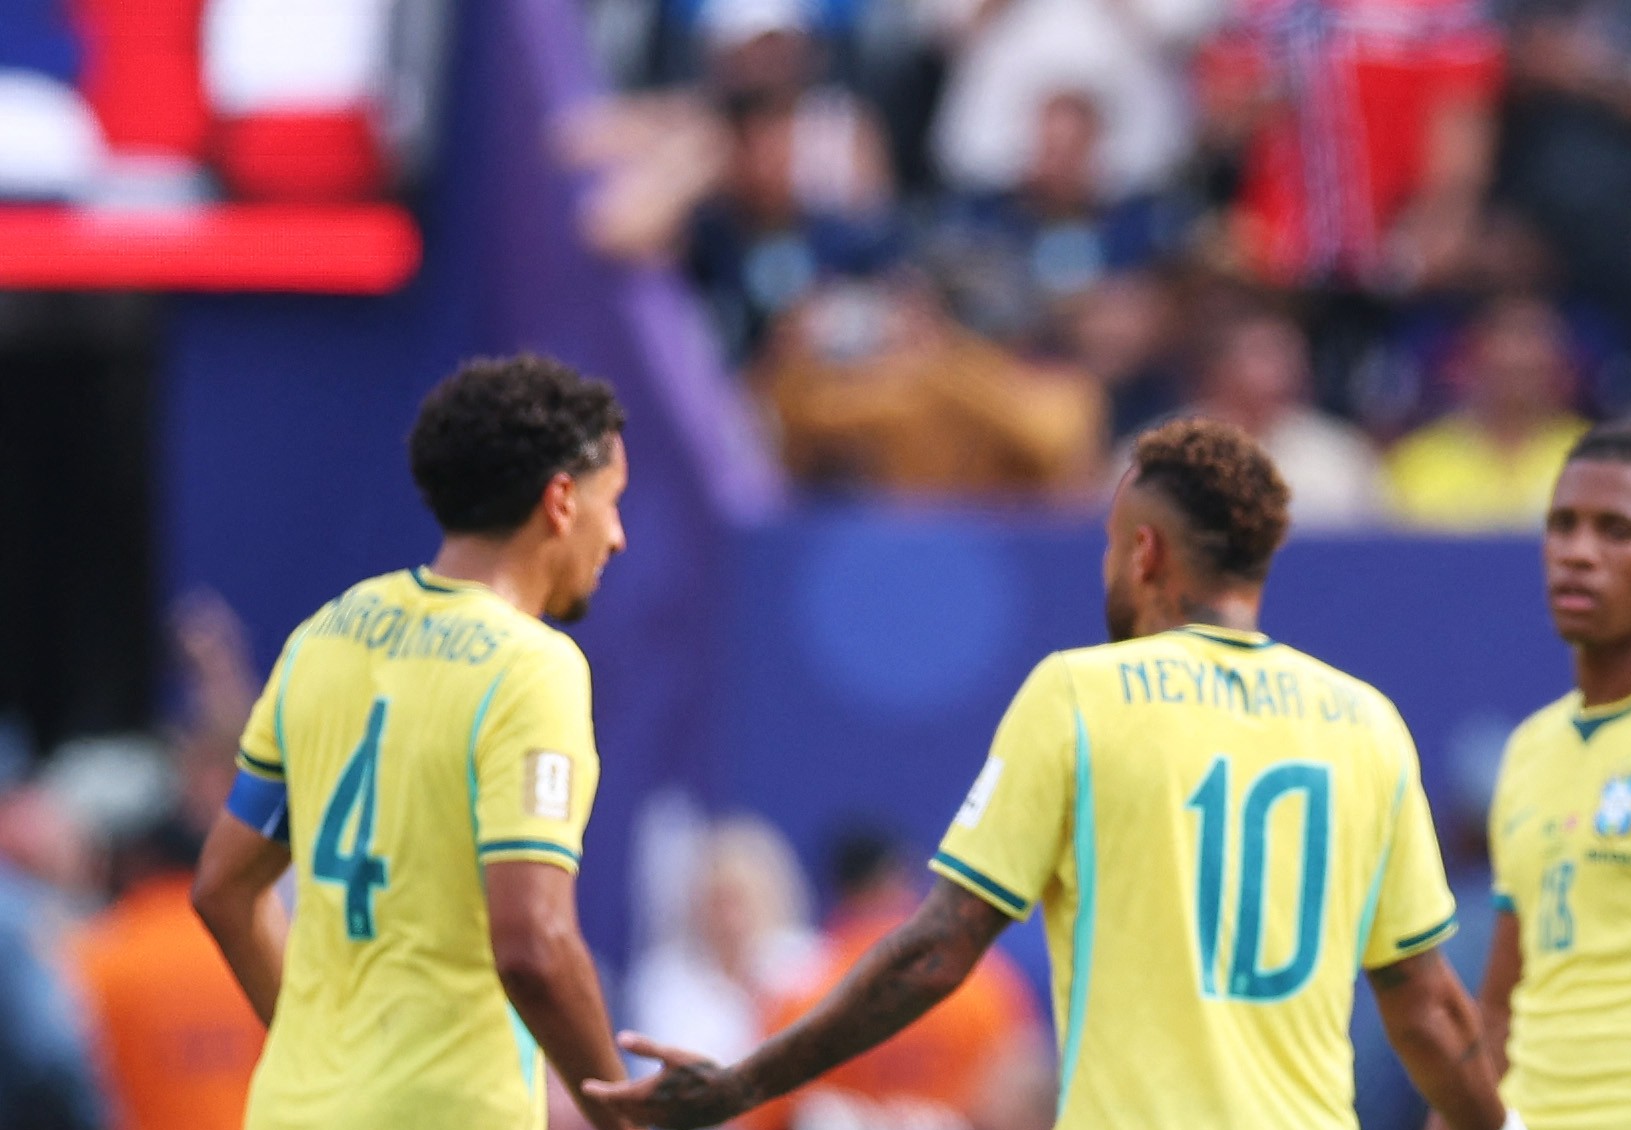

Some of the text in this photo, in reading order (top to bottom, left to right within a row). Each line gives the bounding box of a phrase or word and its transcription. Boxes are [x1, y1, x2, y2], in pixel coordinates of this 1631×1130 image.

[1118, 658, 1305, 719] NEYMAR
[312, 695, 391, 941] 4
[1185, 755, 1335, 1004] 10
